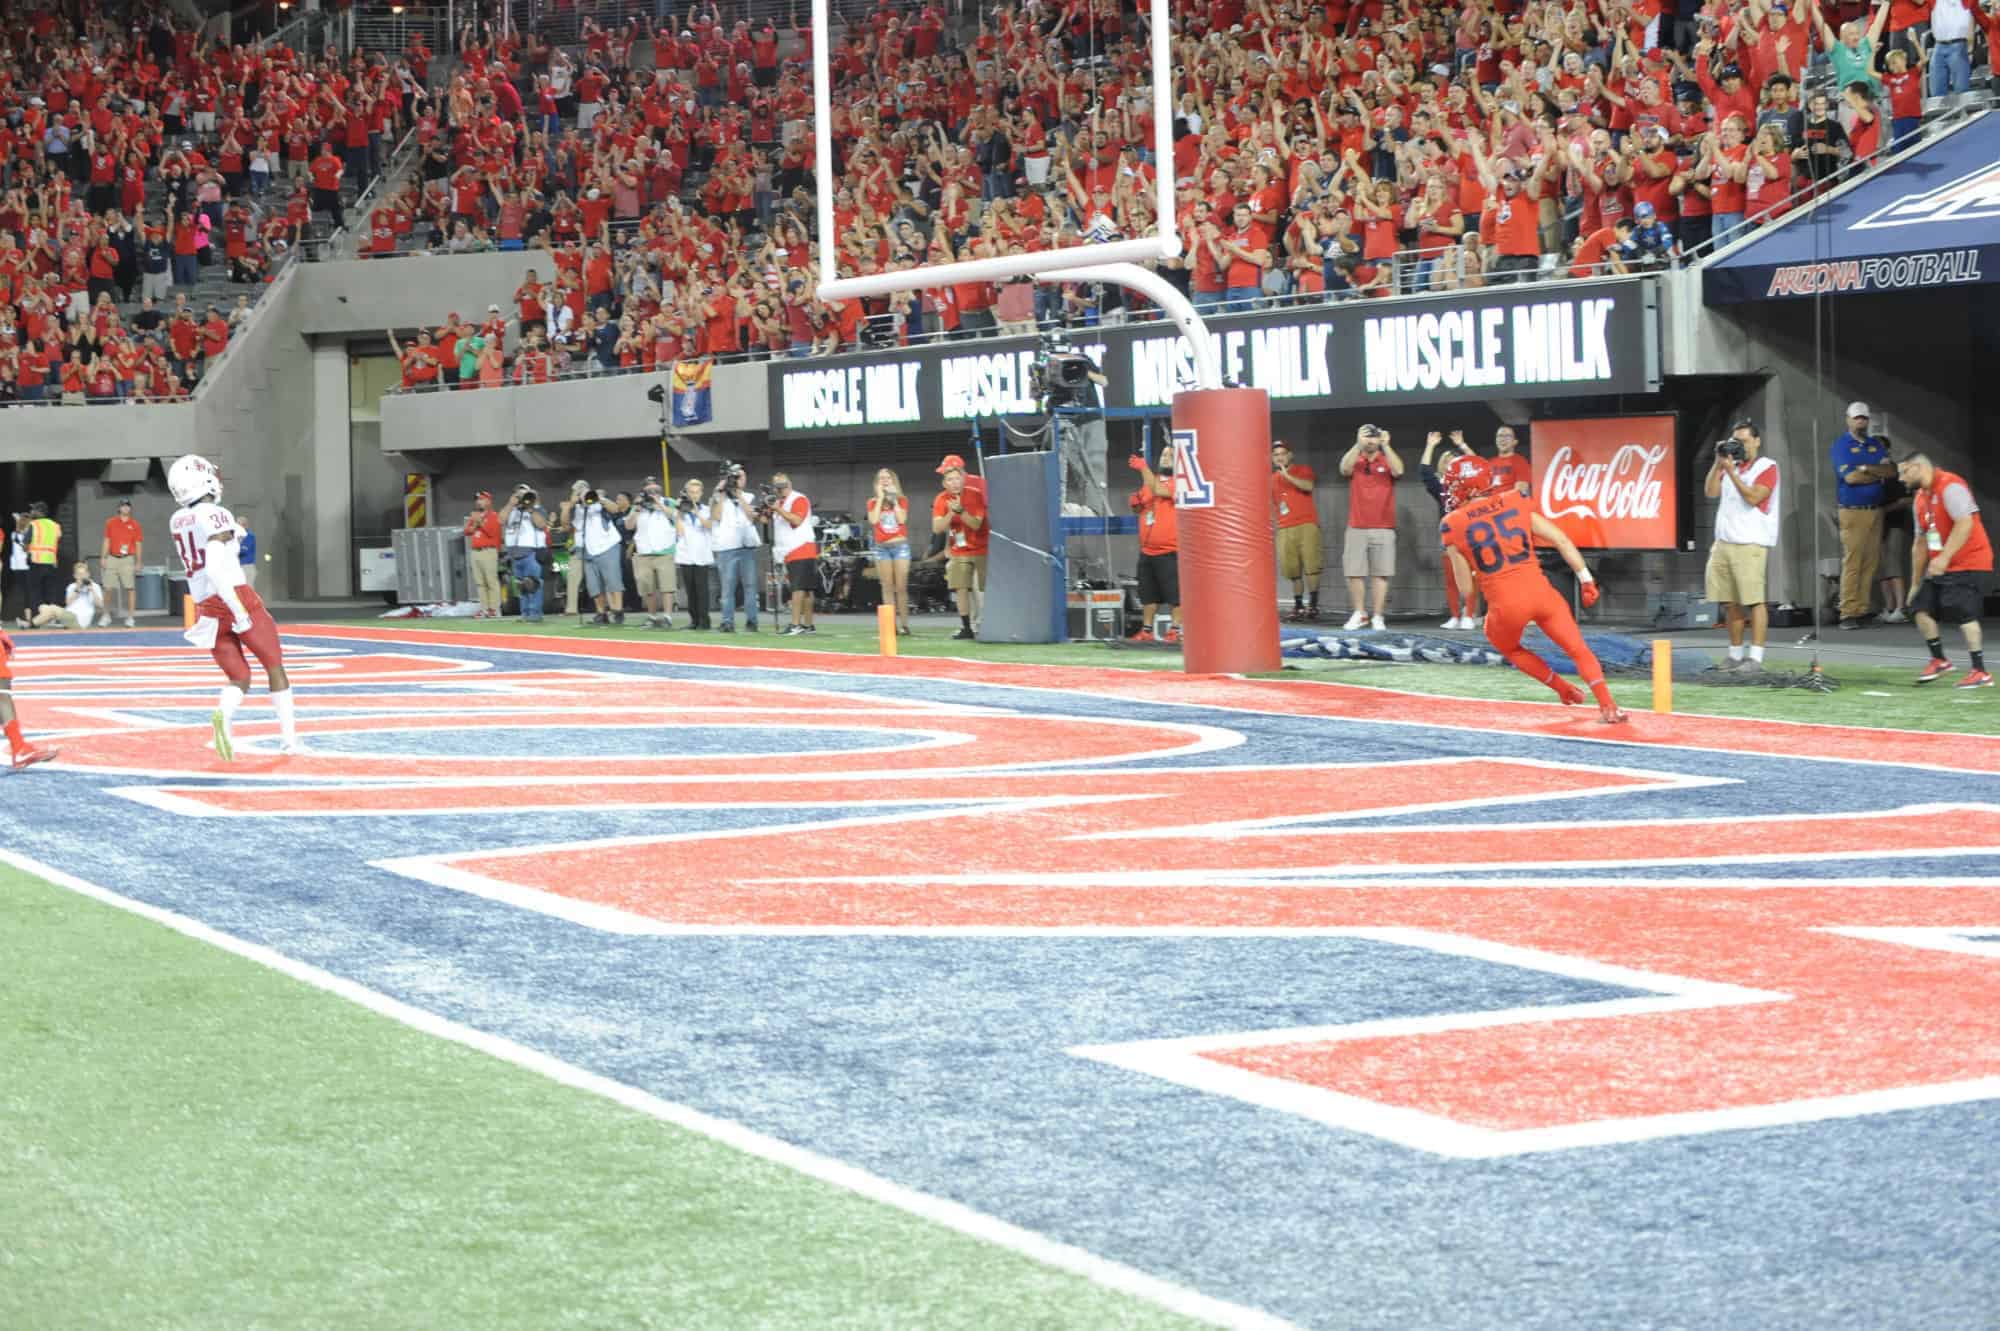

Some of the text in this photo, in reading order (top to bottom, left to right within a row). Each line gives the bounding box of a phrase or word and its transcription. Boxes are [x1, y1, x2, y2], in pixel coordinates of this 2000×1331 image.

[1767, 250, 1981, 296] ARIZONA FOOTBALL
[1132, 330, 1246, 407] MUSLE
[1252, 323, 1333, 396] MILK
[1364, 298, 1615, 392] MUSCLE MILK
[783, 361, 921, 430] MUSCLE MILK
[1172, 429, 1215, 508] A
[1541, 444, 1667, 519] Coca-Cola
[209, 511, 229, 529] 34
[1466, 508, 1530, 575] 85
